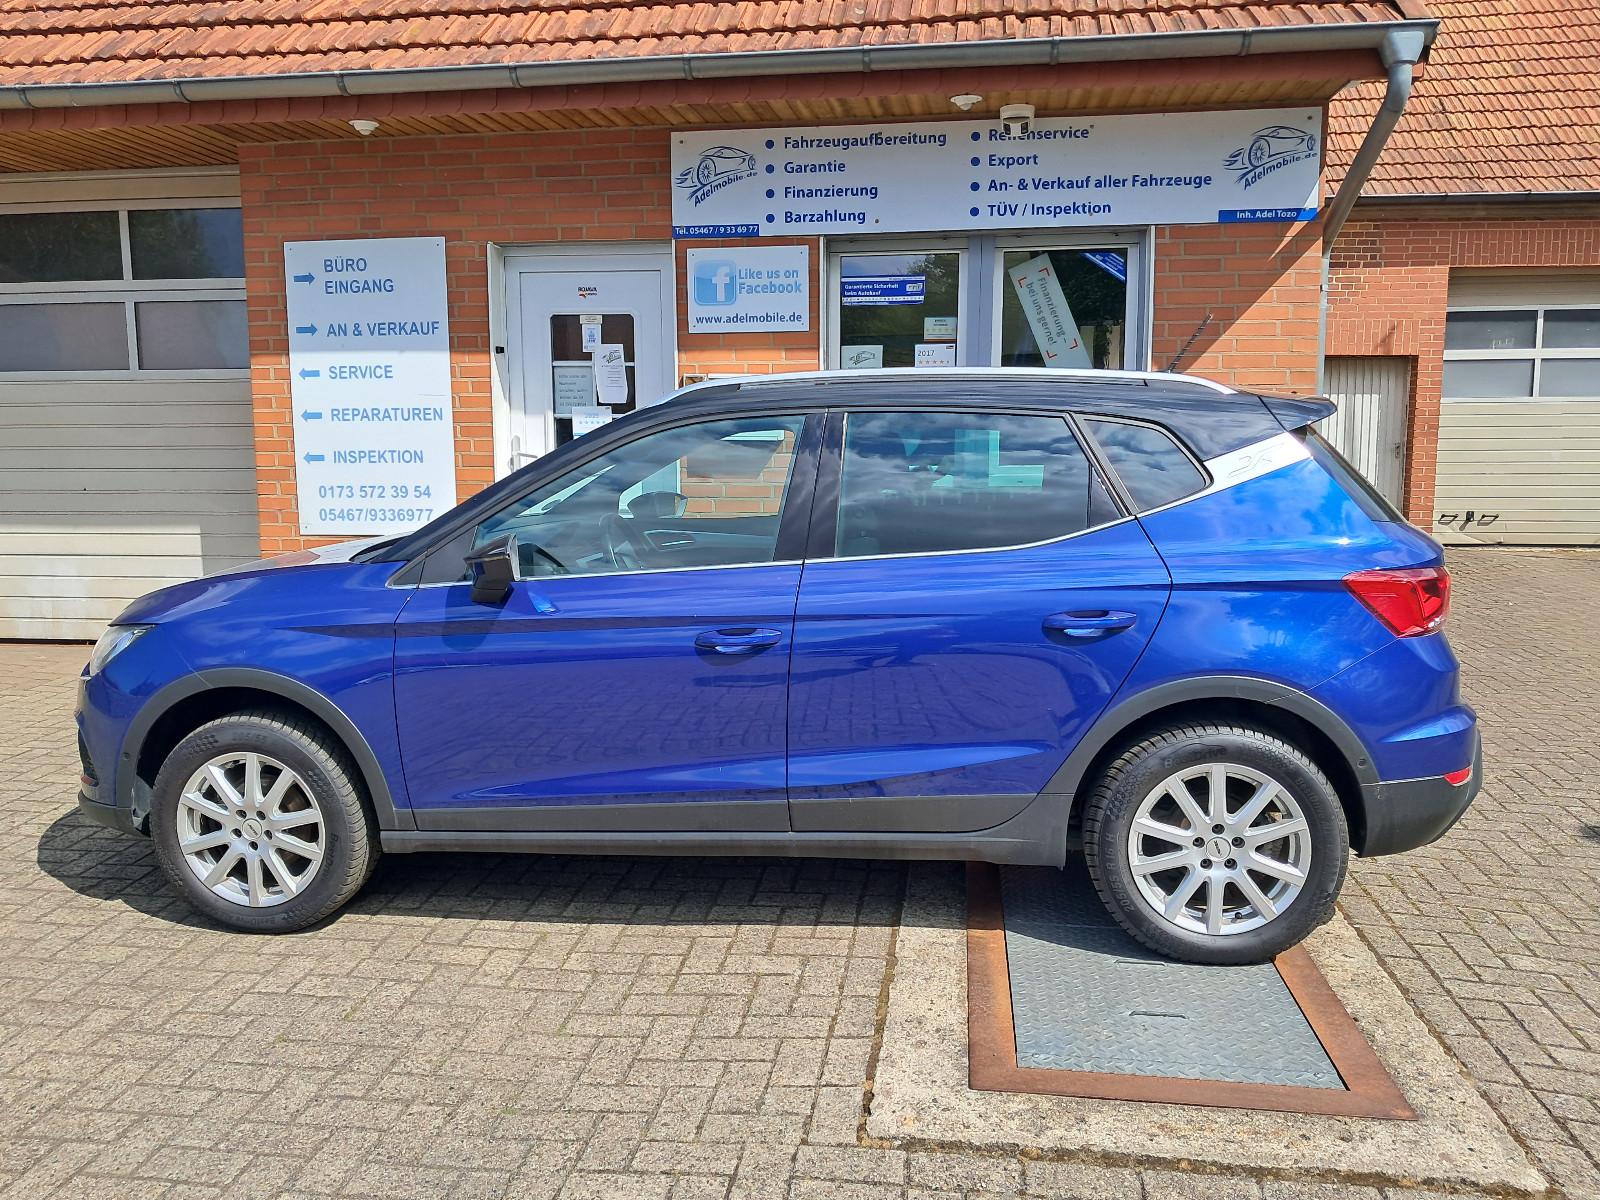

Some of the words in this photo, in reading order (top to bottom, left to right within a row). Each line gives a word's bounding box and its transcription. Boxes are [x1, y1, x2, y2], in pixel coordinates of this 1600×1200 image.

[784, 132, 947, 150] Fahrzeugaufbereitung
[988, 126, 1090, 141] Renservice
[784, 161, 846, 174] Garantie
[988, 153, 1039, 169] Export
[1243, 152, 1318, 191] Adelmobile.de
[694, 171, 758, 208] Adelmobile.de
[987, 178, 1014, 192] An-
[1017, 178, 1029, 191] &
[1031, 175, 1091, 191] Verkauf
[1094, 174, 1129, 189] aller
[1131, 173, 1213, 189] Fahrzeuge
[784, 184, 879, 200] Finanzierung
[784, 209, 866, 224] Barzahlung
[987, 203, 1019, 217] TÜV
[1031, 201, 1112, 218] Inspektion
[1236, 211, 1254, 219] Inh.
[1255, 210, 1275, 218] Adel
[1277, 210, 1297, 218] Tozo
[675, 227, 689, 235] Tel.
[689, 227, 713, 235] 05467
[719, 226, 725, 234] 9
[726, 226, 736, 234] 33
[323, 256, 368, 274] BÜRO
[738, 268, 763, 281] Like
[766, 270, 781, 280] us
[783, 269, 799, 279] on
[324, 279, 395, 295] EINGANG
[738, 281, 803, 295] Facebook
[1025, 282, 1037, 298] bei
[1032, 297, 1044, 317] uns
[1037, 277, 1066, 337] Finanzierung
[695, 312, 803, 325] www.adelmobile.de
[326, 323, 348, 337] AN
[352, 323, 363, 337] &
[367, 321, 440, 336] VERKAUF
[328, 365, 394, 379] SERVICE
[330, 407, 444, 422] REPARATUREN
[333, 450, 424, 464] INSPEKTION
[318, 485, 354, 499] 0173
[359, 485, 386, 499] 572
[391, 485, 409, 499] 39
[413, 485, 432, 499] 54
[318, 508, 434, 523] 05467/9336977
